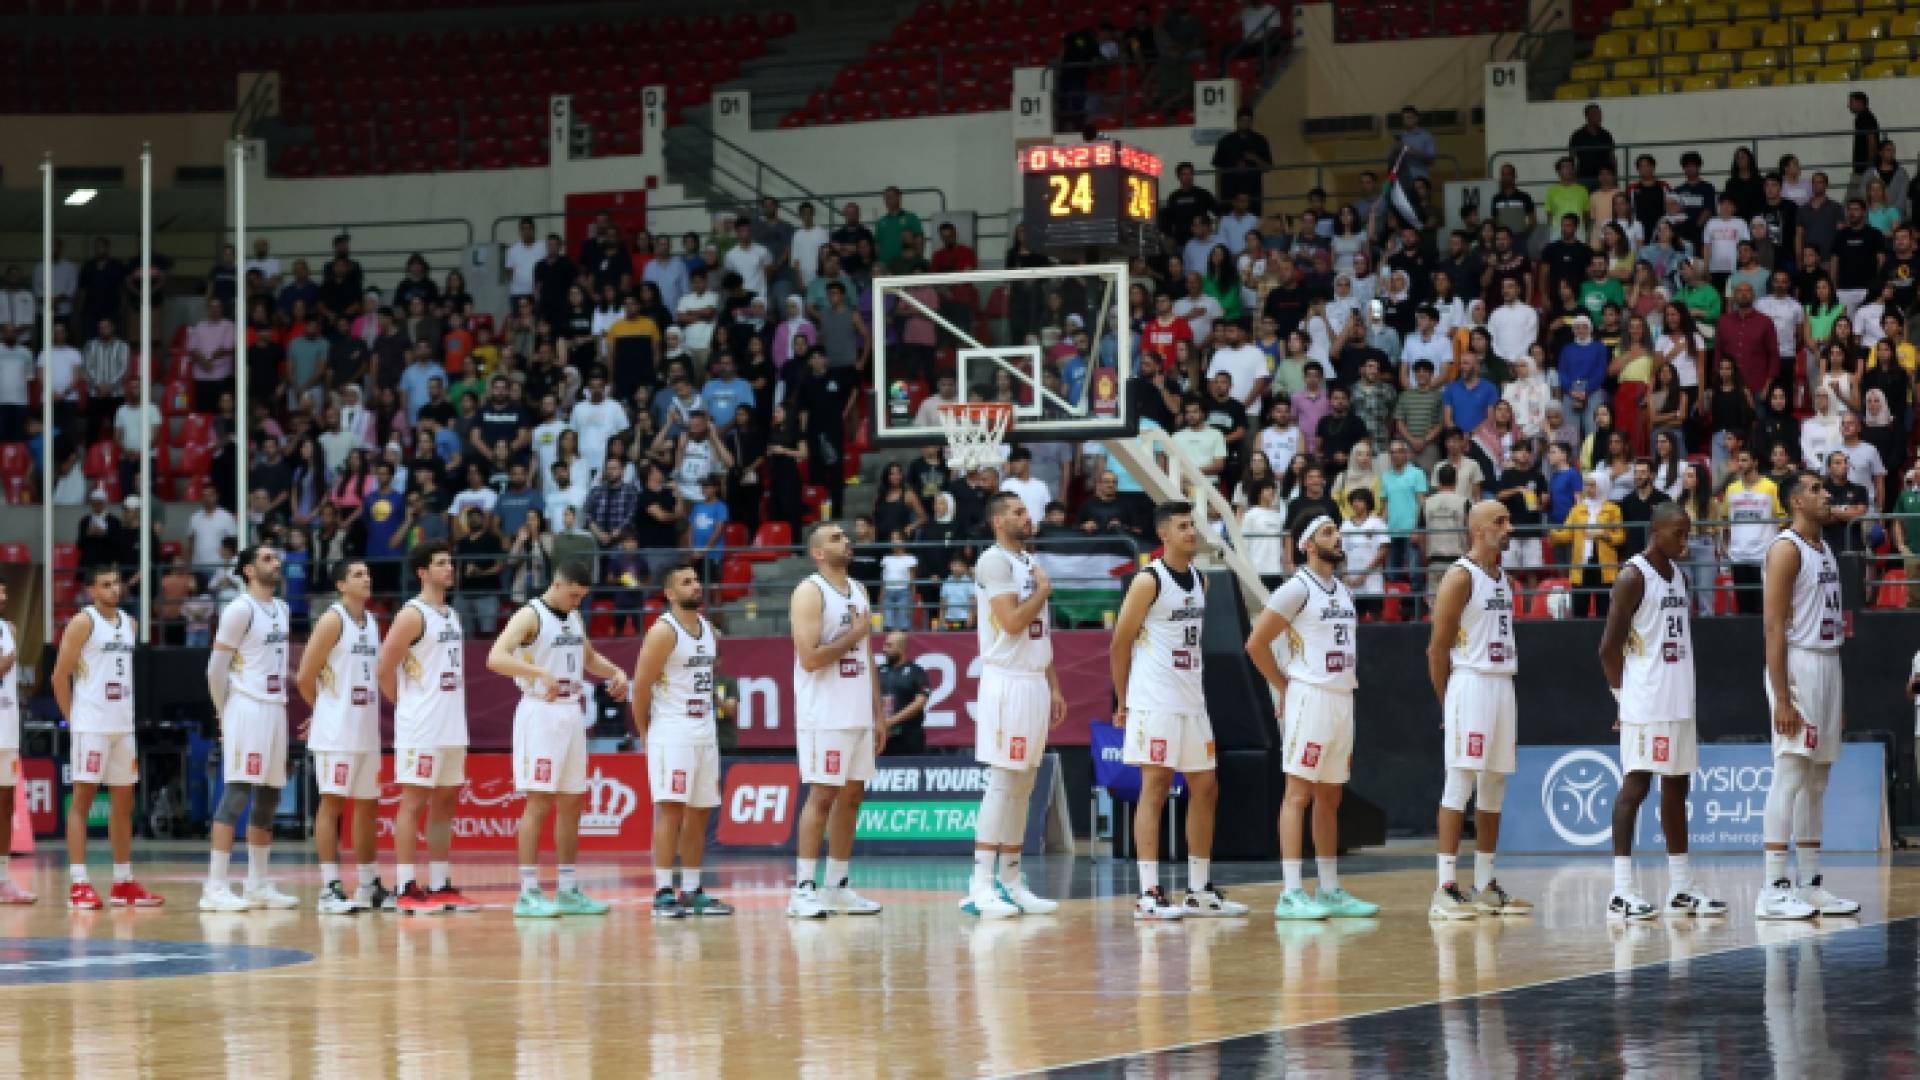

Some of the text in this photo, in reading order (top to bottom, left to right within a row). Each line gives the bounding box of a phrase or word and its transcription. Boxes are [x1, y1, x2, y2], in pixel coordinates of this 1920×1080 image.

[1493, 67, 1516, 86] D1
[1203, 86, 1224, 105] D1
[720, 97, 741, 115] D1
[1020, 97, 1041, 116] D1
[1030, 145, 1112, 170] 04:28
[1049, 172, 1152, 219] 24 24
[1665, 616, 1683, 638] 24
[730, 784, 789, 823] CFI
